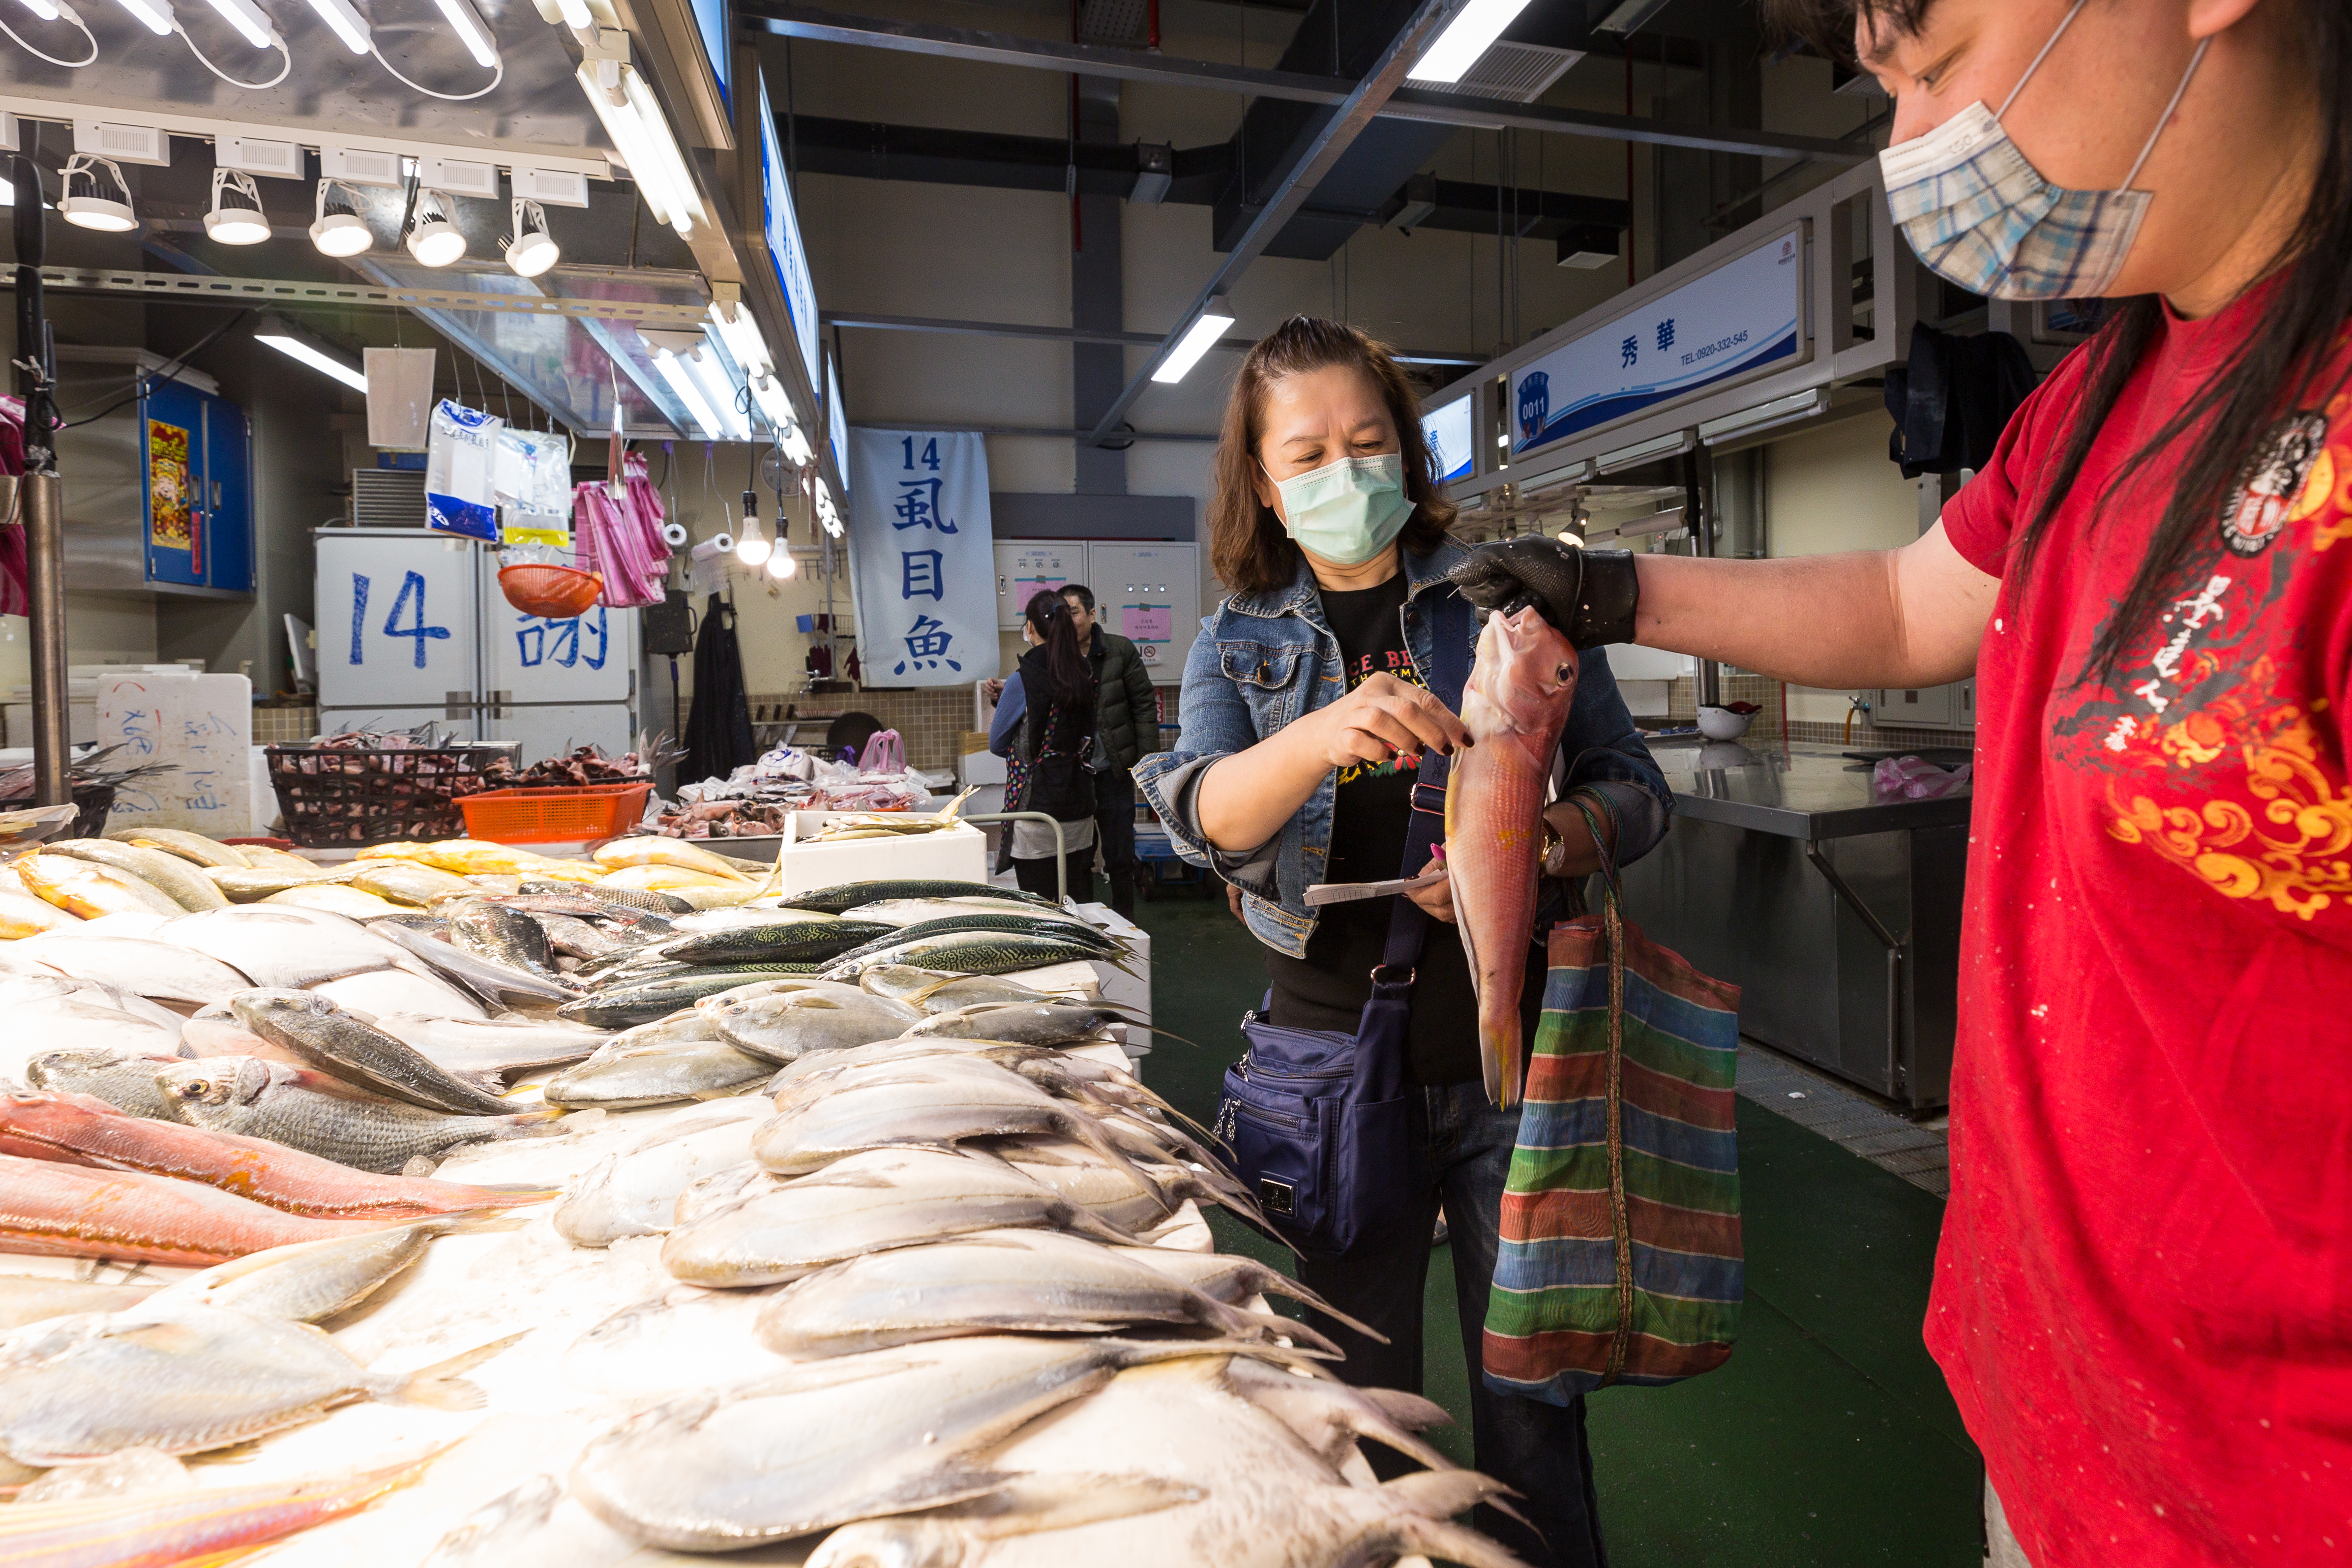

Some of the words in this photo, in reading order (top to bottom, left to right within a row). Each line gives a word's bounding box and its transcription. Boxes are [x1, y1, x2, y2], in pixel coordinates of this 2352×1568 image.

[1622, 318, 1675, 369] 秀華
[1681, 330, 1748, 366] TEL:0920-332-545
[1522, 396, 1544, 420] 0011
[902, 436, 940, 471] 14
[892, 477, 962, 675] 虱目魚
[349, 570, 451, 669] 14
